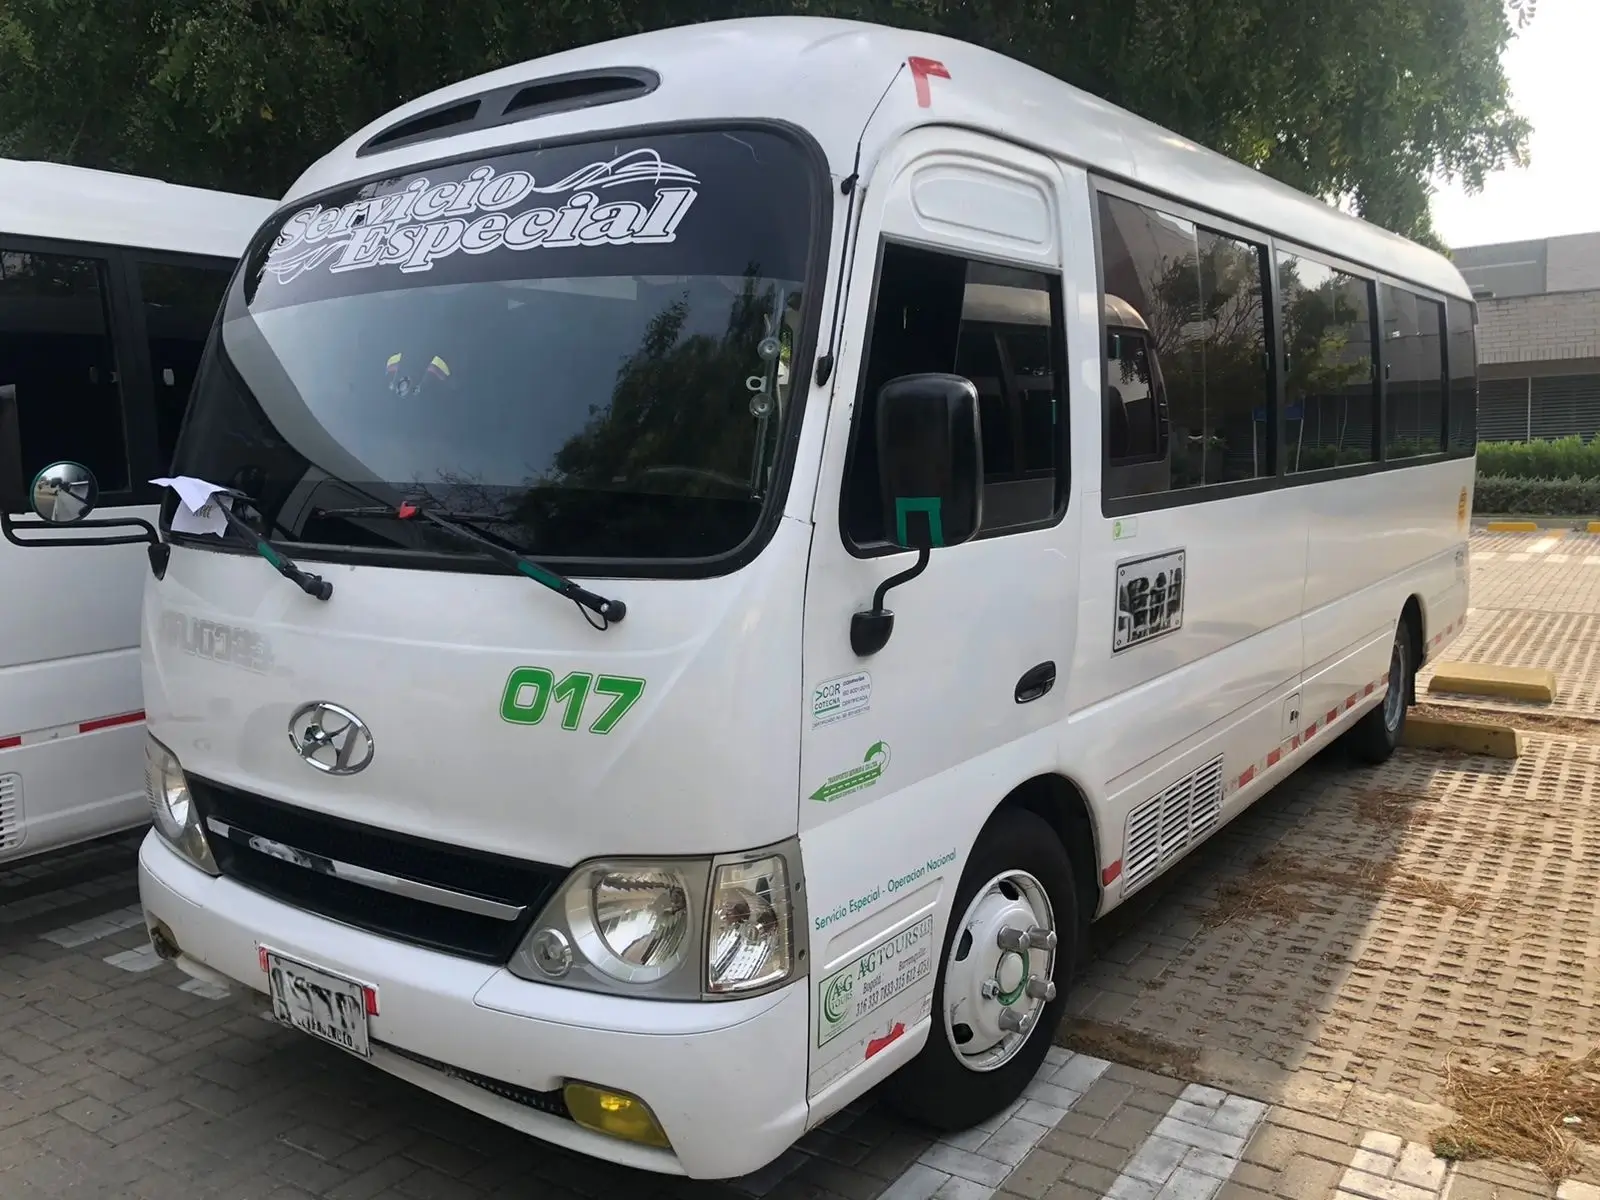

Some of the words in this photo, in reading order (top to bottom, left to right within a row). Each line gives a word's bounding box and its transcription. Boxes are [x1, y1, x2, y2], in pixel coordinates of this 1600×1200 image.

[269, 164, 536, 257] Servicio
[330, 187, 697, 274] Especial
[500, 666, 646, 735] 017
[815, 697, 840, 710] COTECNA
[815, 902, 847, 930] Servicio
[849, 886, 881, 914] Especial
[887, 867, 926, 893] Operacion
[926, 847, 957, 873] Nacional
